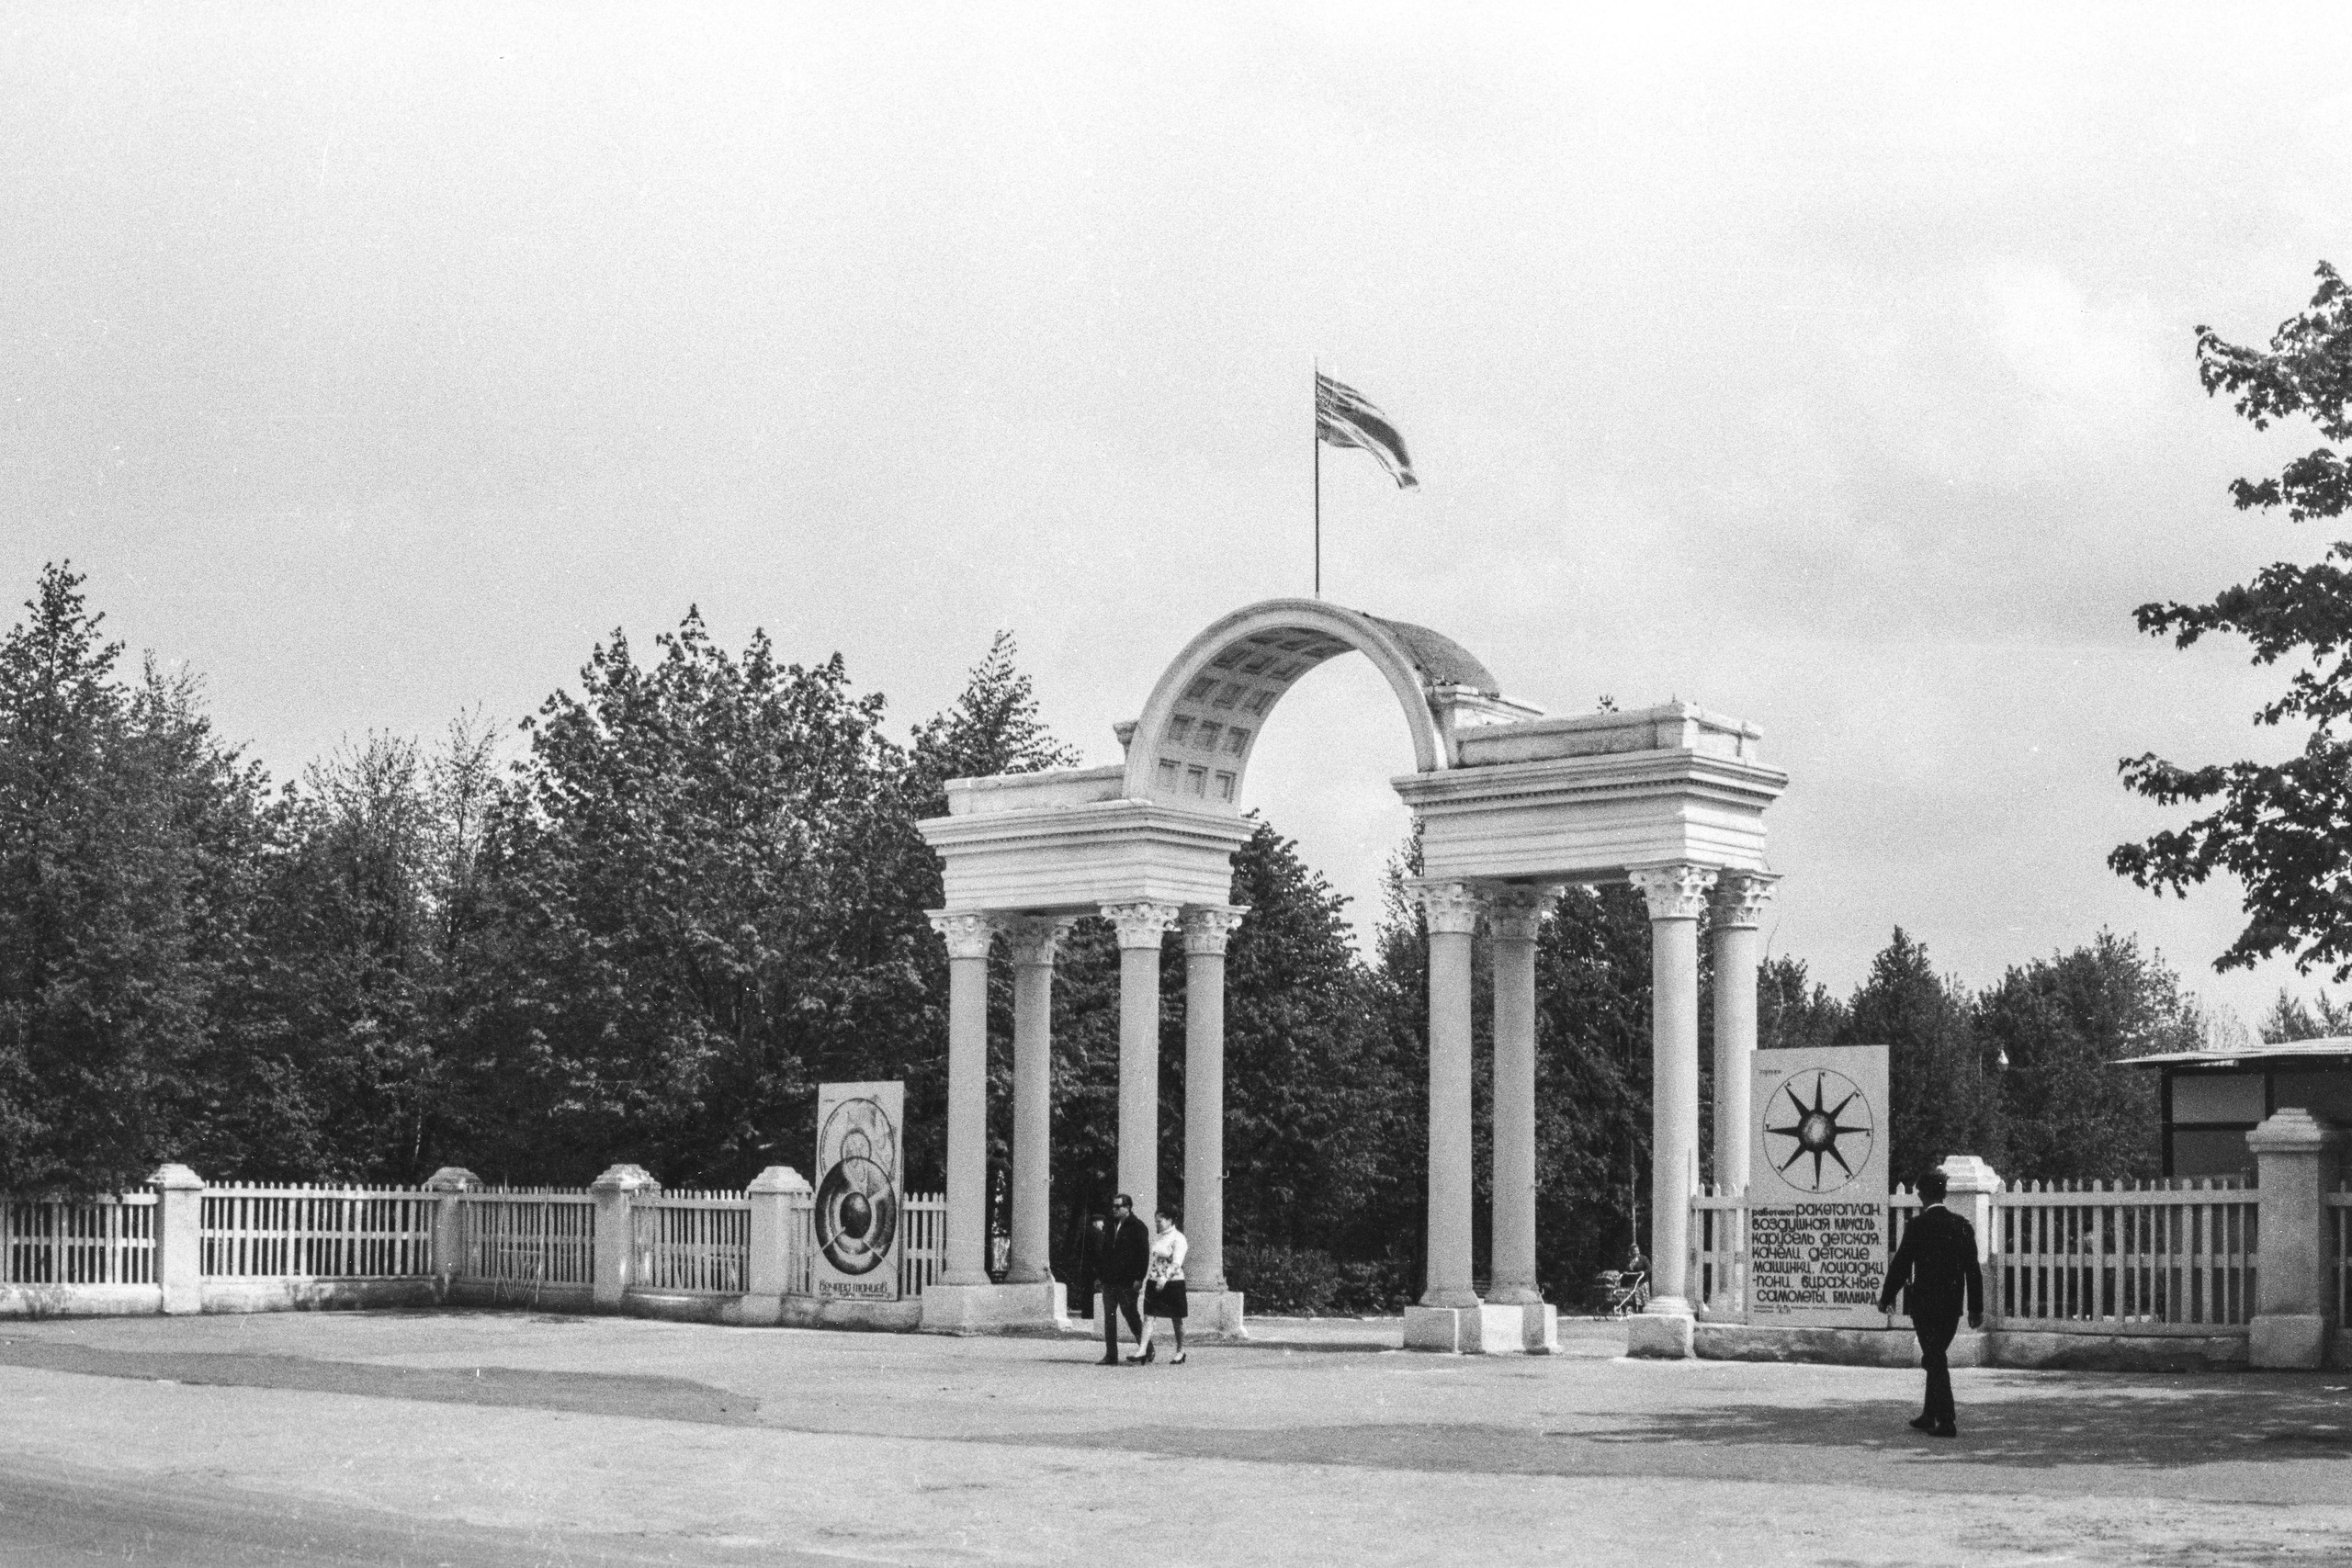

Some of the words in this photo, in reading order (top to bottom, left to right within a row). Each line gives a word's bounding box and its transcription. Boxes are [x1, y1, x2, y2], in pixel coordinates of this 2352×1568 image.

[1751, 1207, 1795, 1218] работают
[1751, 1218, 1830, 1232] воздушная
[1751, 1232, 1815, 1247] карусель
[1808, 1247, 1870, 1261] детские
[1820, 1261, 1884, 1276] лошадки
[1801, 1275, 1880, 1290] виражные
